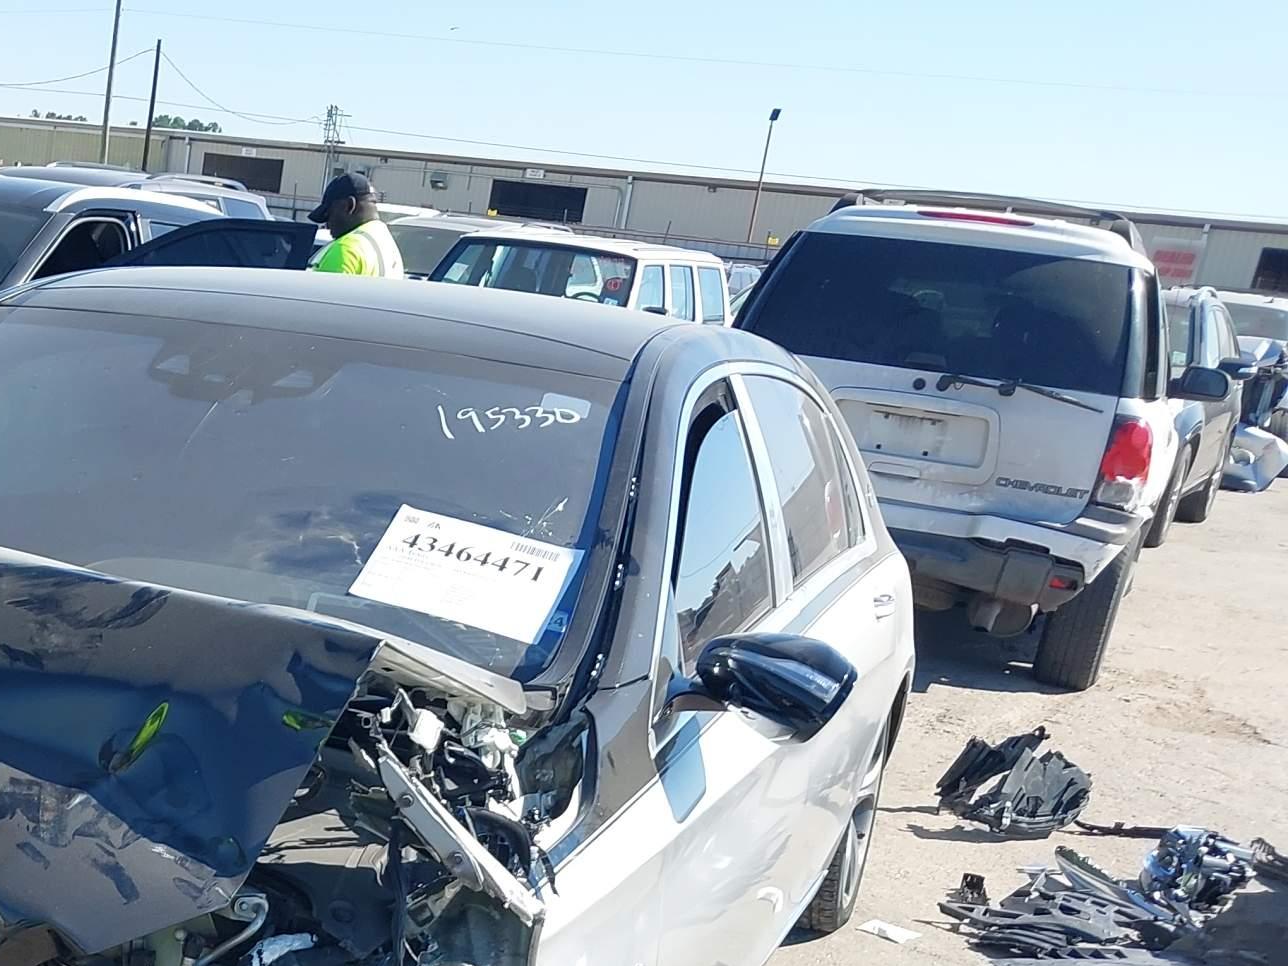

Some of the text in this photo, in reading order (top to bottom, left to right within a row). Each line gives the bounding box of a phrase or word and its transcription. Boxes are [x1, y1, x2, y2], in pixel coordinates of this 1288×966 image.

[437, 404, 581, 440] 195330
[995, 476, 1090, 500] CHEVROLET
[402, 533, 545, 582] 43464471
